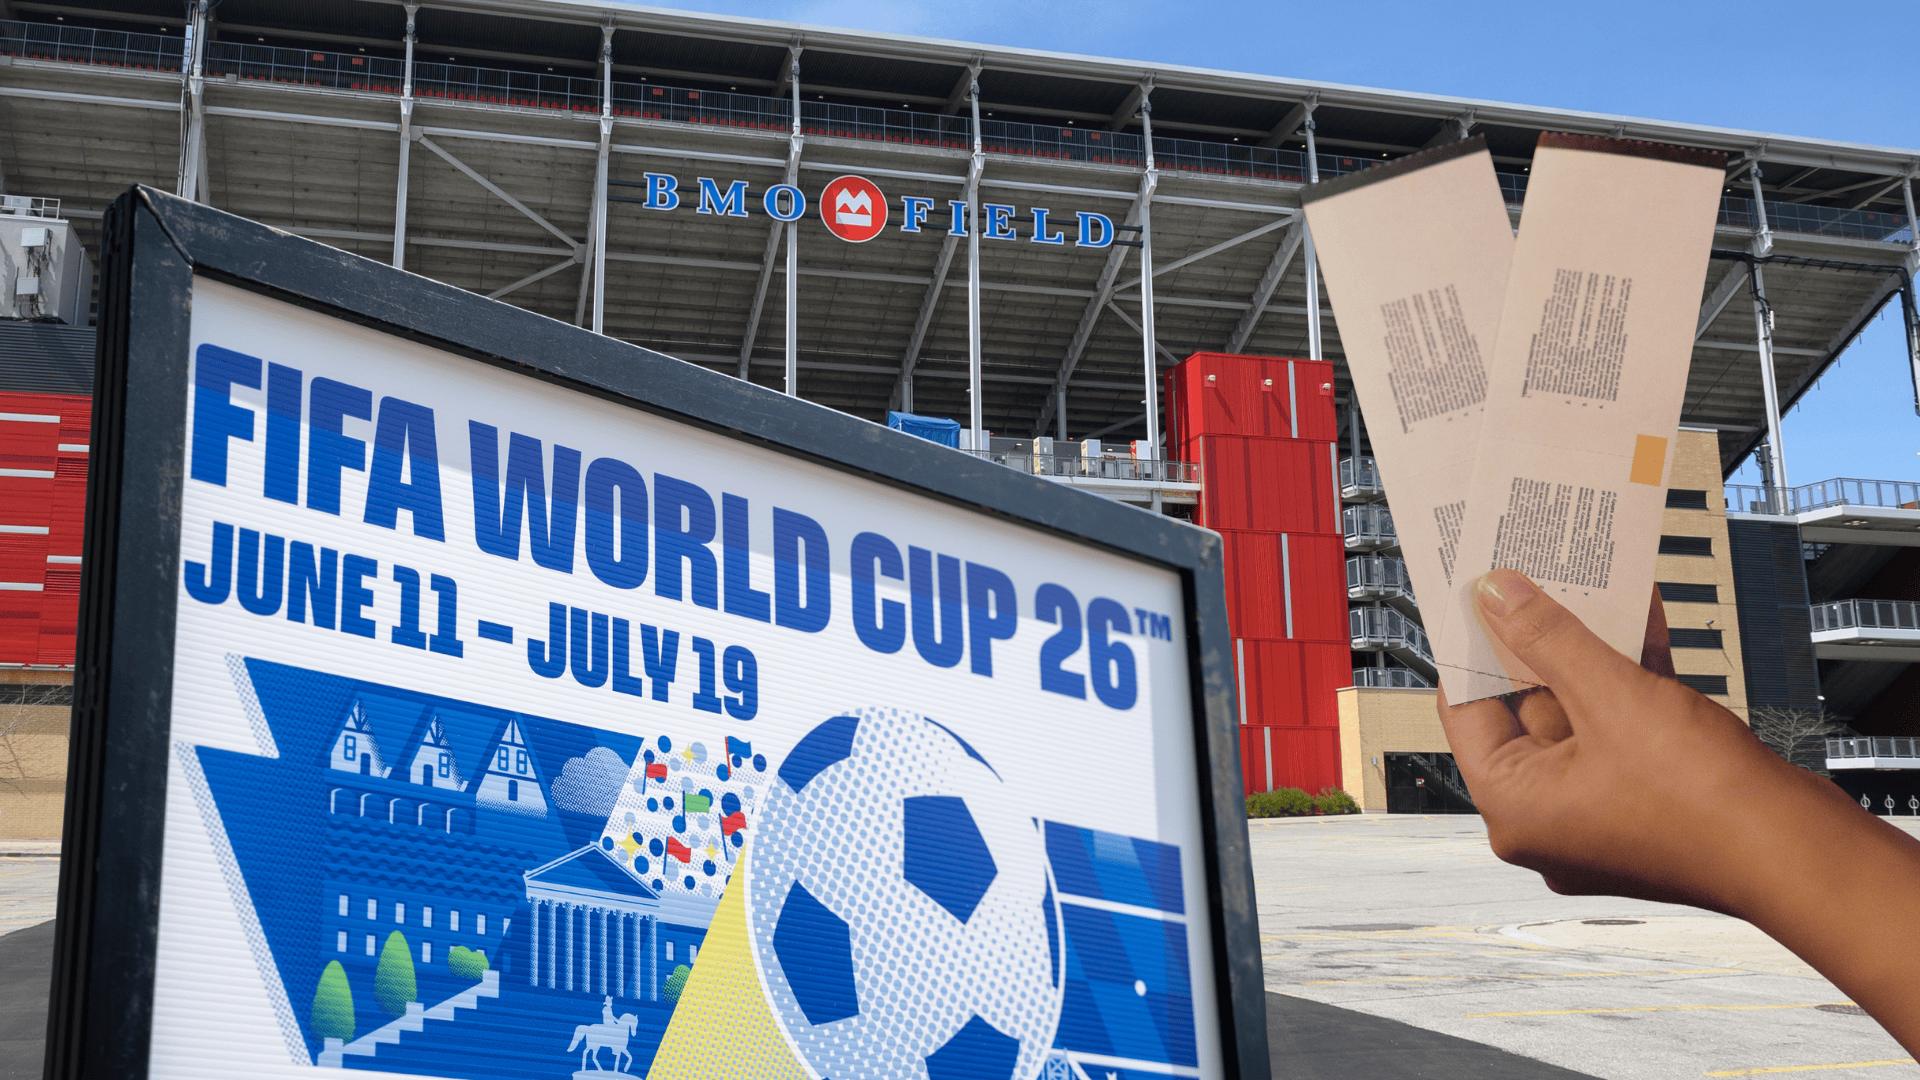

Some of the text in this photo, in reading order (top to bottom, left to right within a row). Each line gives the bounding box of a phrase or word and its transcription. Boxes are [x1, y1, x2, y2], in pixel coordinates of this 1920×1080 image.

[642, 171, 1115, 249] BMO FIELD
[190, 342, 446, 543] FIFA
[468, 419, 832, 634] WORLD
[850, 531, 1018, 679] CUP
[184, 521, 378, 640] JUNE
[391, 563, 464, 658] 11
[527, 602, 680, 704] JULY
[692, 635, 759, 721] 19
